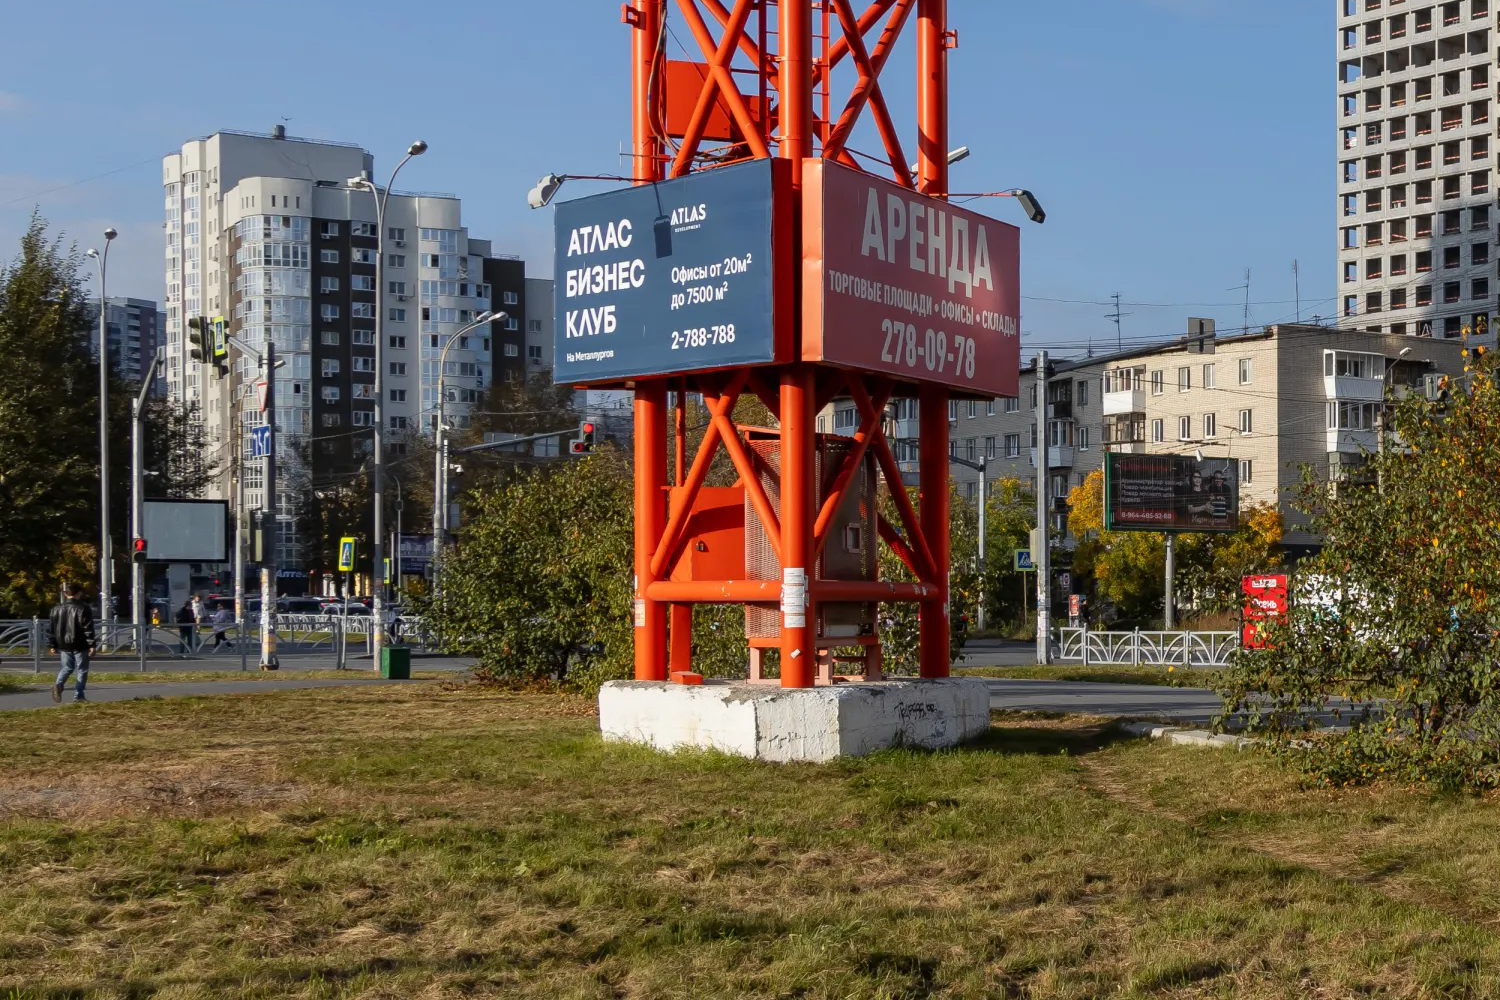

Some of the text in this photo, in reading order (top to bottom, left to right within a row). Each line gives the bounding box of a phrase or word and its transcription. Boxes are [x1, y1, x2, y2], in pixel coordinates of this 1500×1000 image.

[670, 203, 707, 226] ATLAS
[567, 218, 633, 257] АТЛАС
[861, 187, 994, 299] АРЕНДА
[566, 258, 646, 298] БИЗНЕС
[671, 265, 708, 286] Офисы
[709, 263, 722, 278] от
[670, 292, 685, 311] до
[686, 284, 713, 305] 7500
[828, 269, 1017, 338] ТОРГОВЫЕ ПЛОЩАДИ ОФИСЫ СКЛАДЫ
[566, 305, 617, 339] КЛУБ
[671, 323, 736, 350] 2-788-788
[566, 349, 614, 364] На Металлургов
[881, 318, 976, 379] 278-09-78
